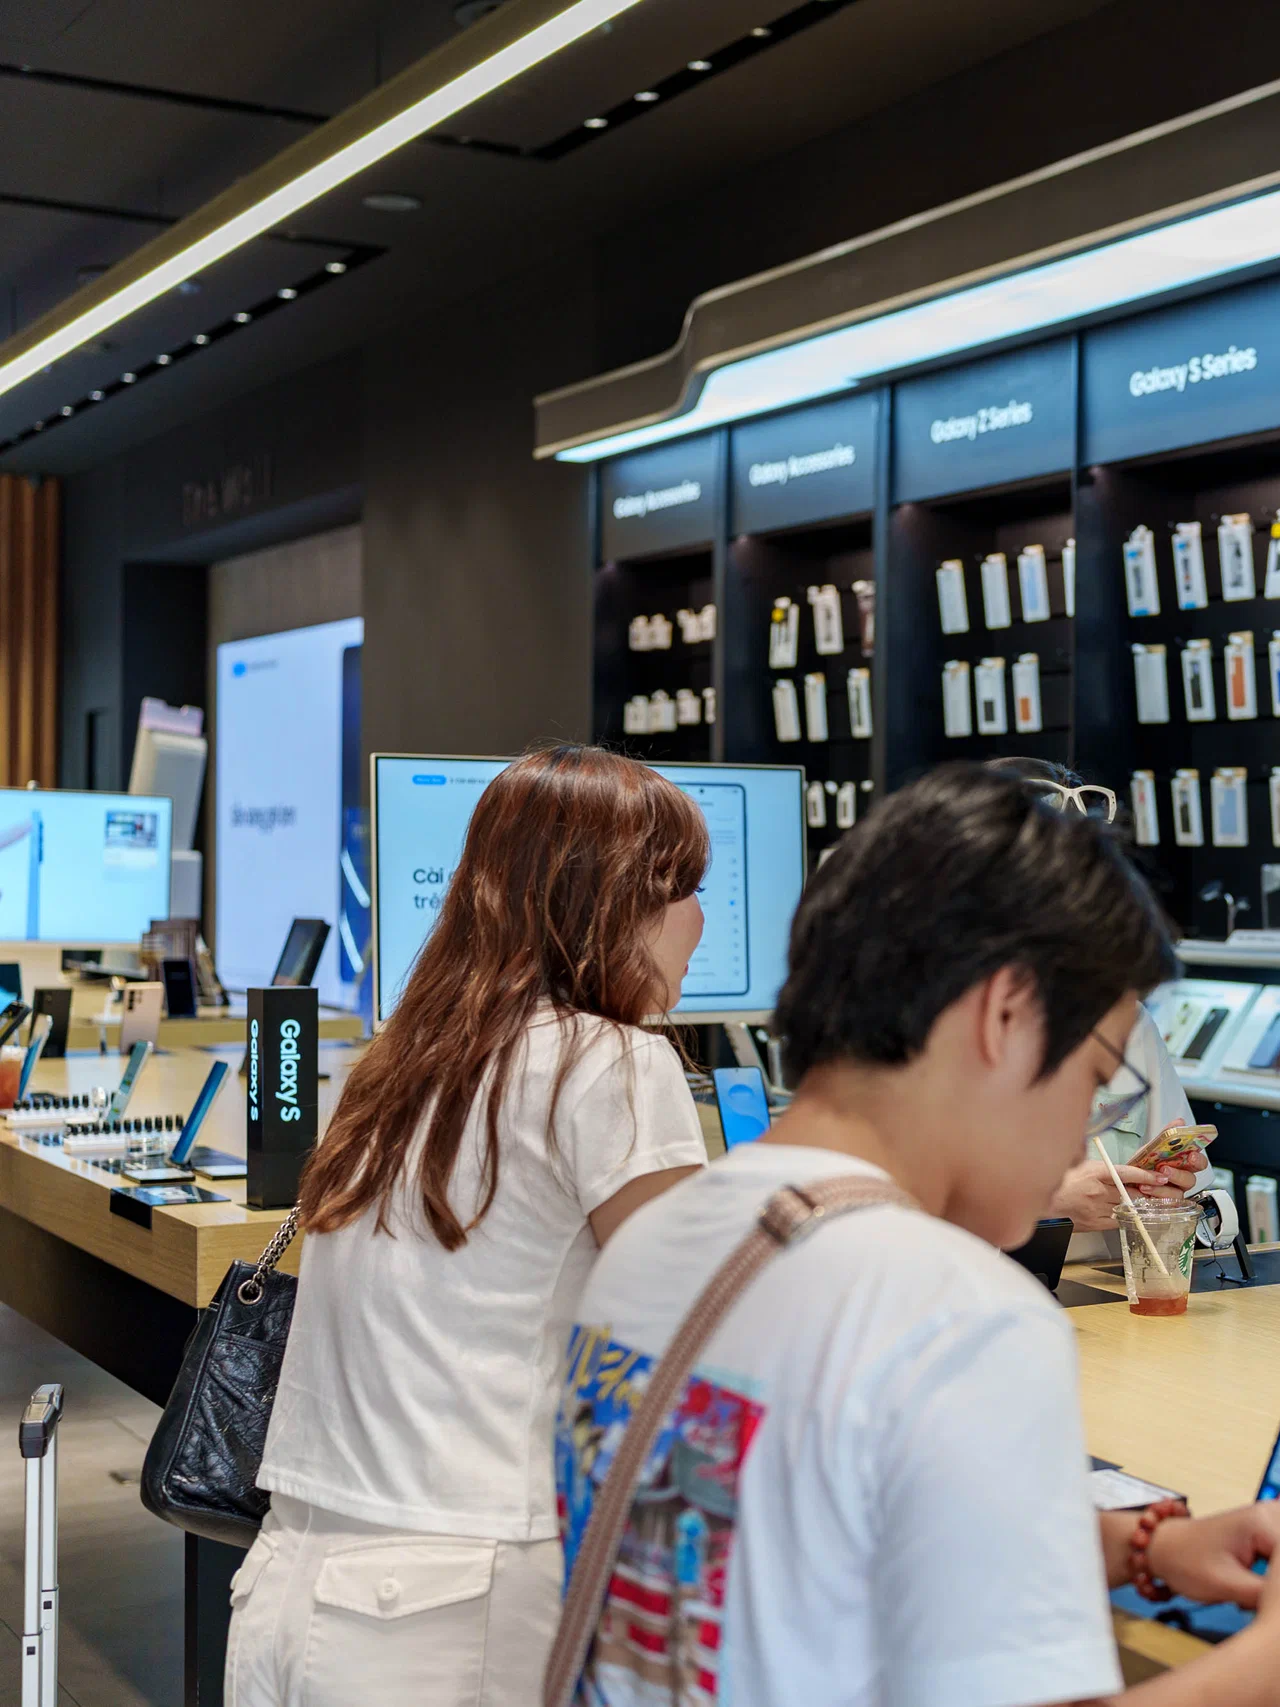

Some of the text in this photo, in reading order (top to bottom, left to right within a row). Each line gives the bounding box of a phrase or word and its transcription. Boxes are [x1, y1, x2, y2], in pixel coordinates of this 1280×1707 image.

[1129, 345, 1257, 397] Galaxy S Series
[930, 414, 978, 444] Galaxy
[987, 399, 1033, 431] Series
[249, 1018, 259, 1122] Galaxy S
[275, 1019, 301, 1122] Galaxy S
